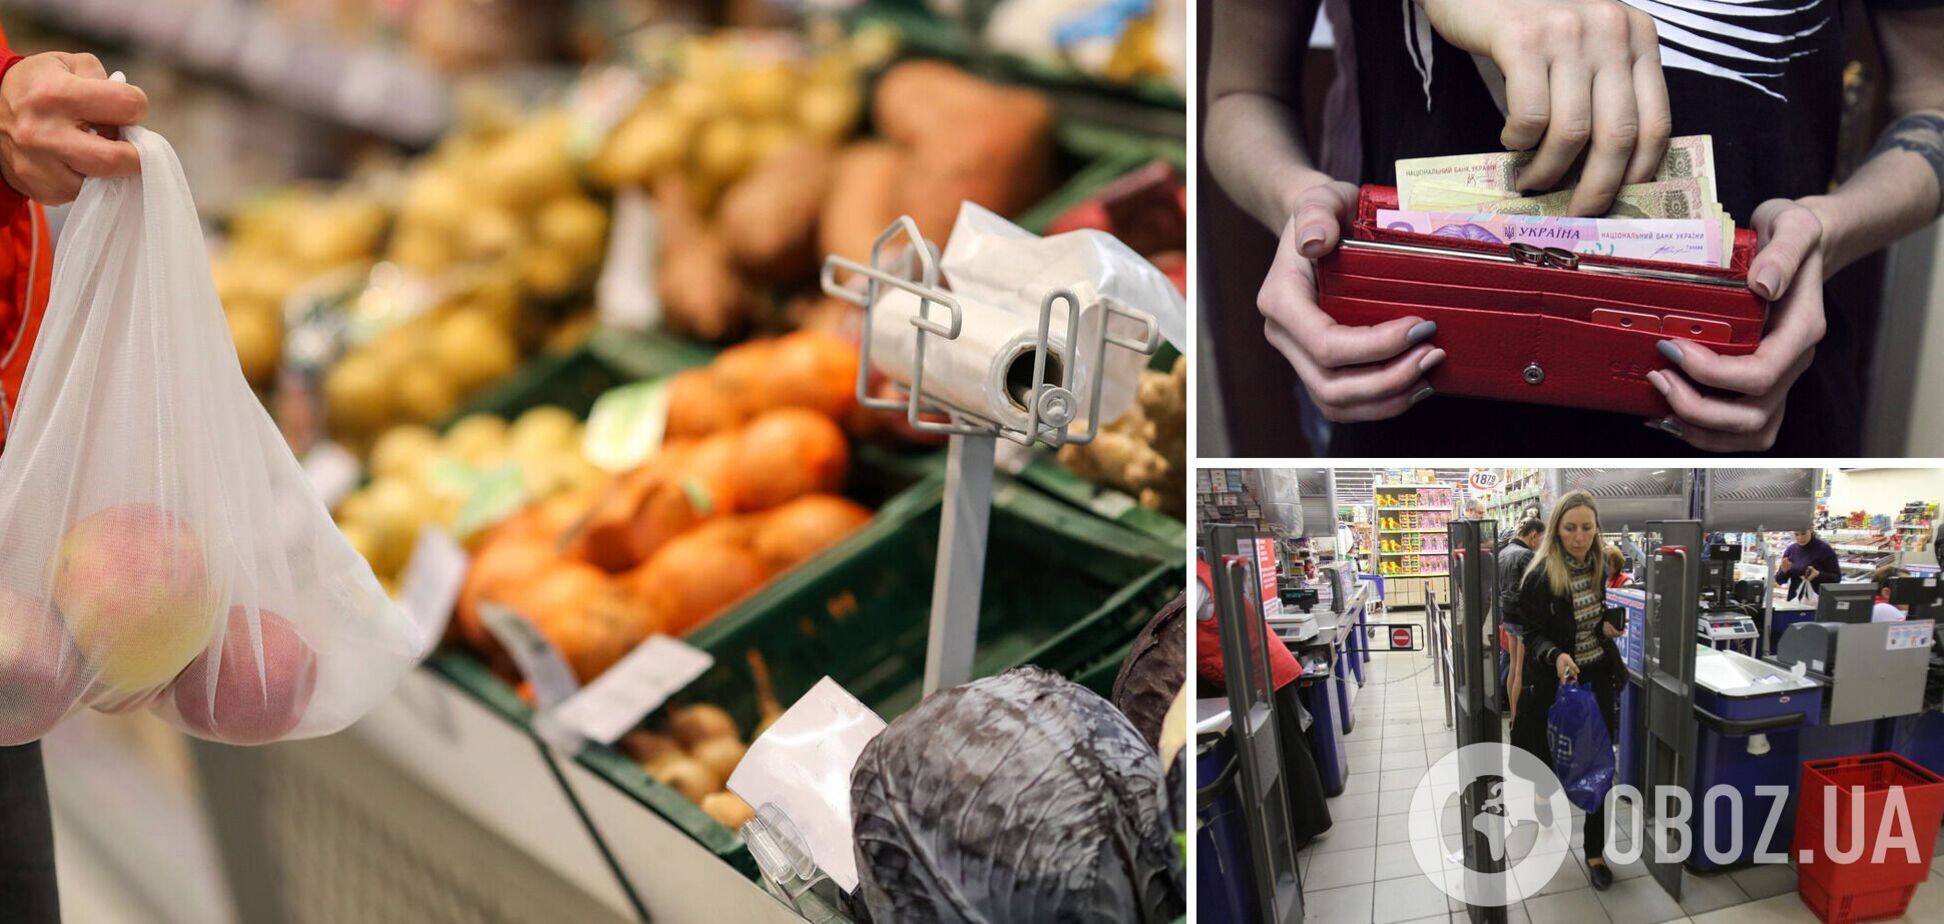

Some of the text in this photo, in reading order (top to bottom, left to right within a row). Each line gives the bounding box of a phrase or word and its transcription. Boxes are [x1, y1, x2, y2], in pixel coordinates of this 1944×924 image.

[1405, 166, 1453, 177] НАЦІОНАЛЬНИЙ
[1454, 165, 1470, 174] БАНК
[1518, 226, 1580, 240] УКРАЇНА
[1601, 232, 1653, 240] НАЦІОНАЛЬНИЙ
